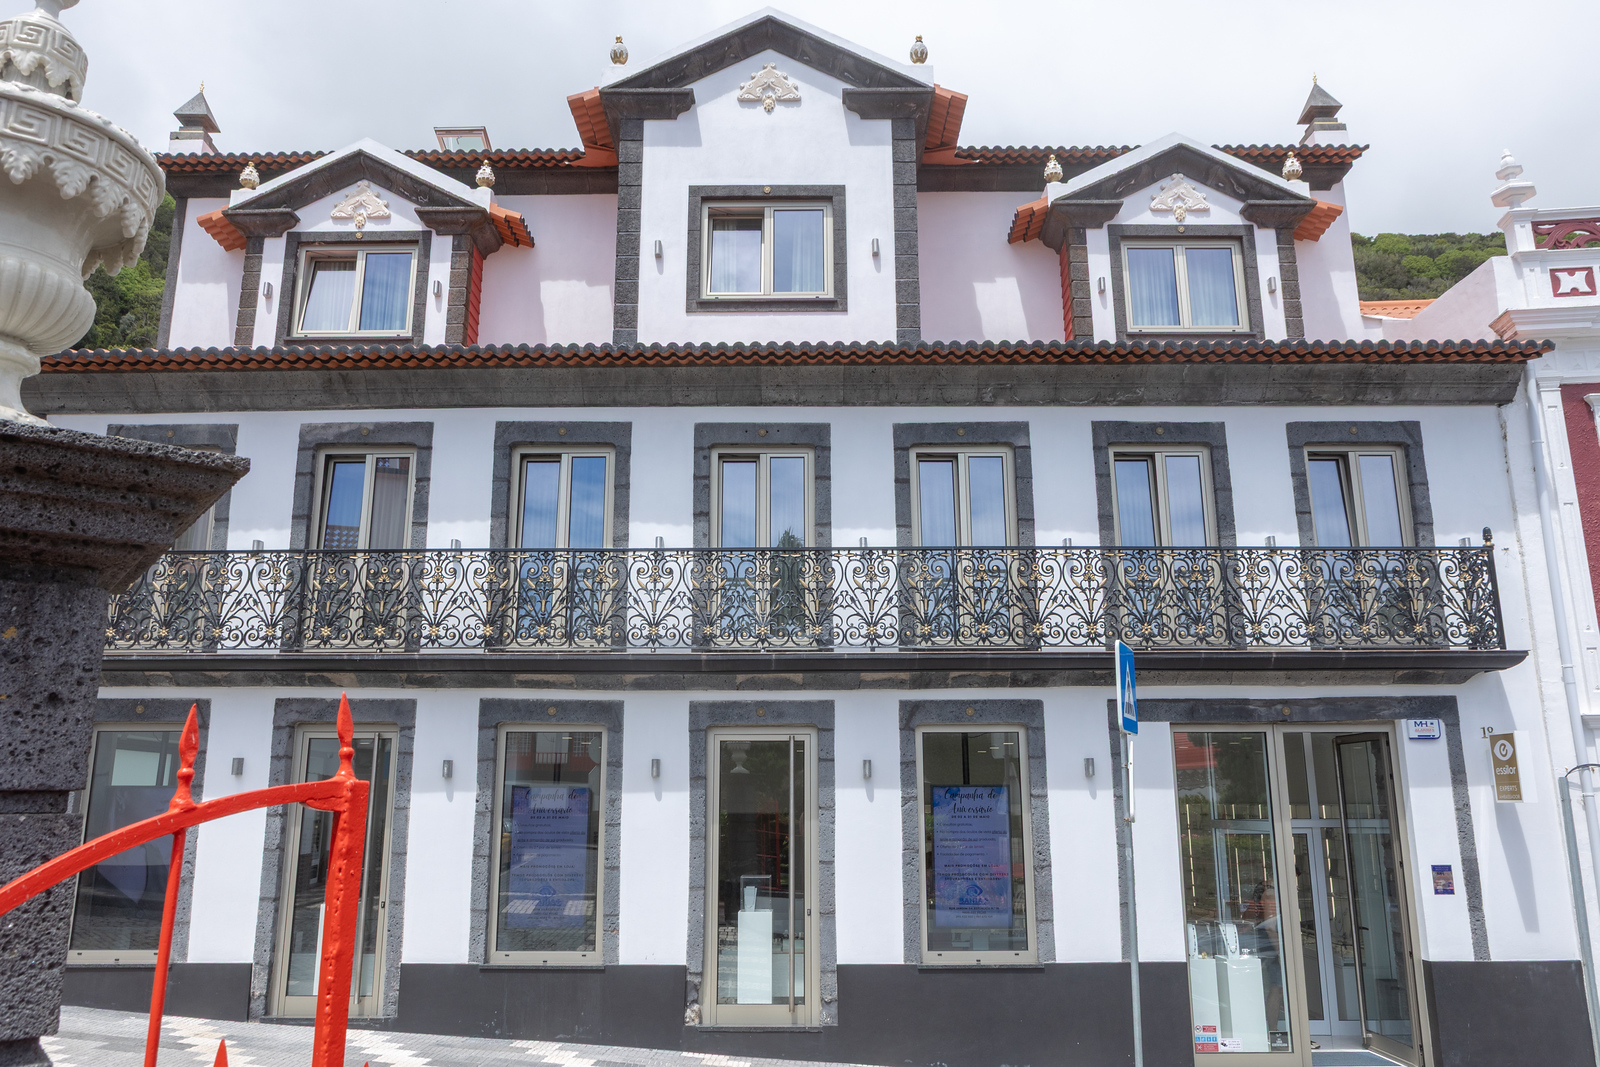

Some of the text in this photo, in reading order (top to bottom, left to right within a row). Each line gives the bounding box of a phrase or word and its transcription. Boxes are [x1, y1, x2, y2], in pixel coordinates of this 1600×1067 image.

[1496, 765, 1516, 775] essilor
[525, 789, 578, 804] Campanha de
[944, 788, 997, 804] Campanha de
[952, 803, 993, 813] Aniversário
